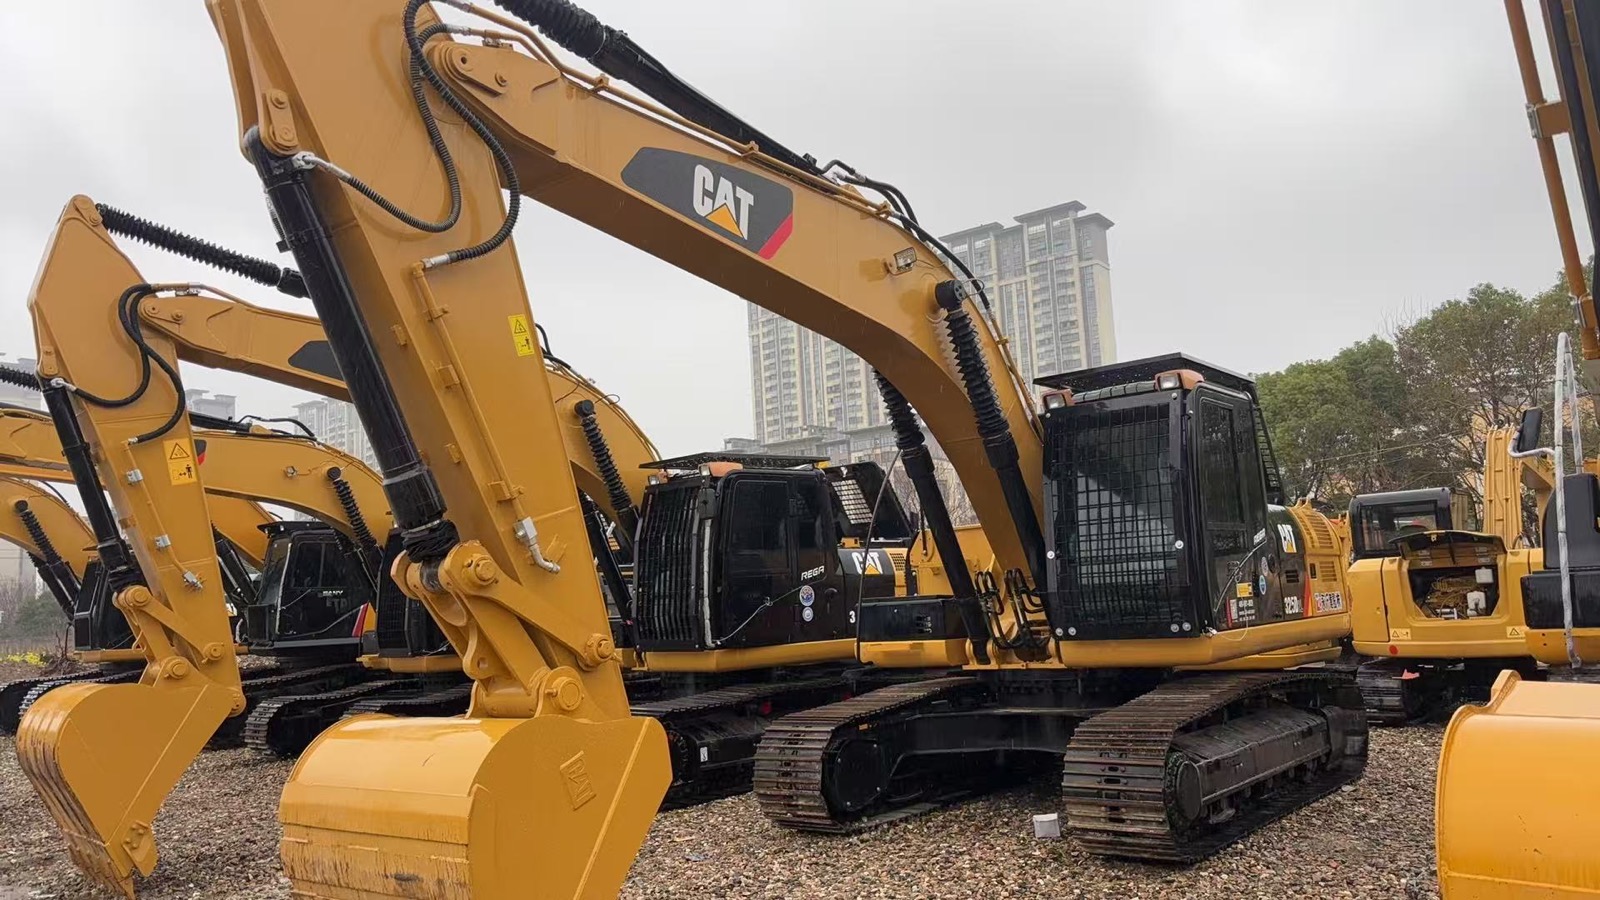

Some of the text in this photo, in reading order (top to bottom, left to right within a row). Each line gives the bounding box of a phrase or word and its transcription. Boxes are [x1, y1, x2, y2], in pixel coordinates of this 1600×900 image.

[694, 164, 753, 239] CAT
[1277, 524, 1296, 553] CAT
[801, 566, 824, 581] REGA
[852, 551, 884, 575] CAT
[567, 759, 594, 802] CAT
